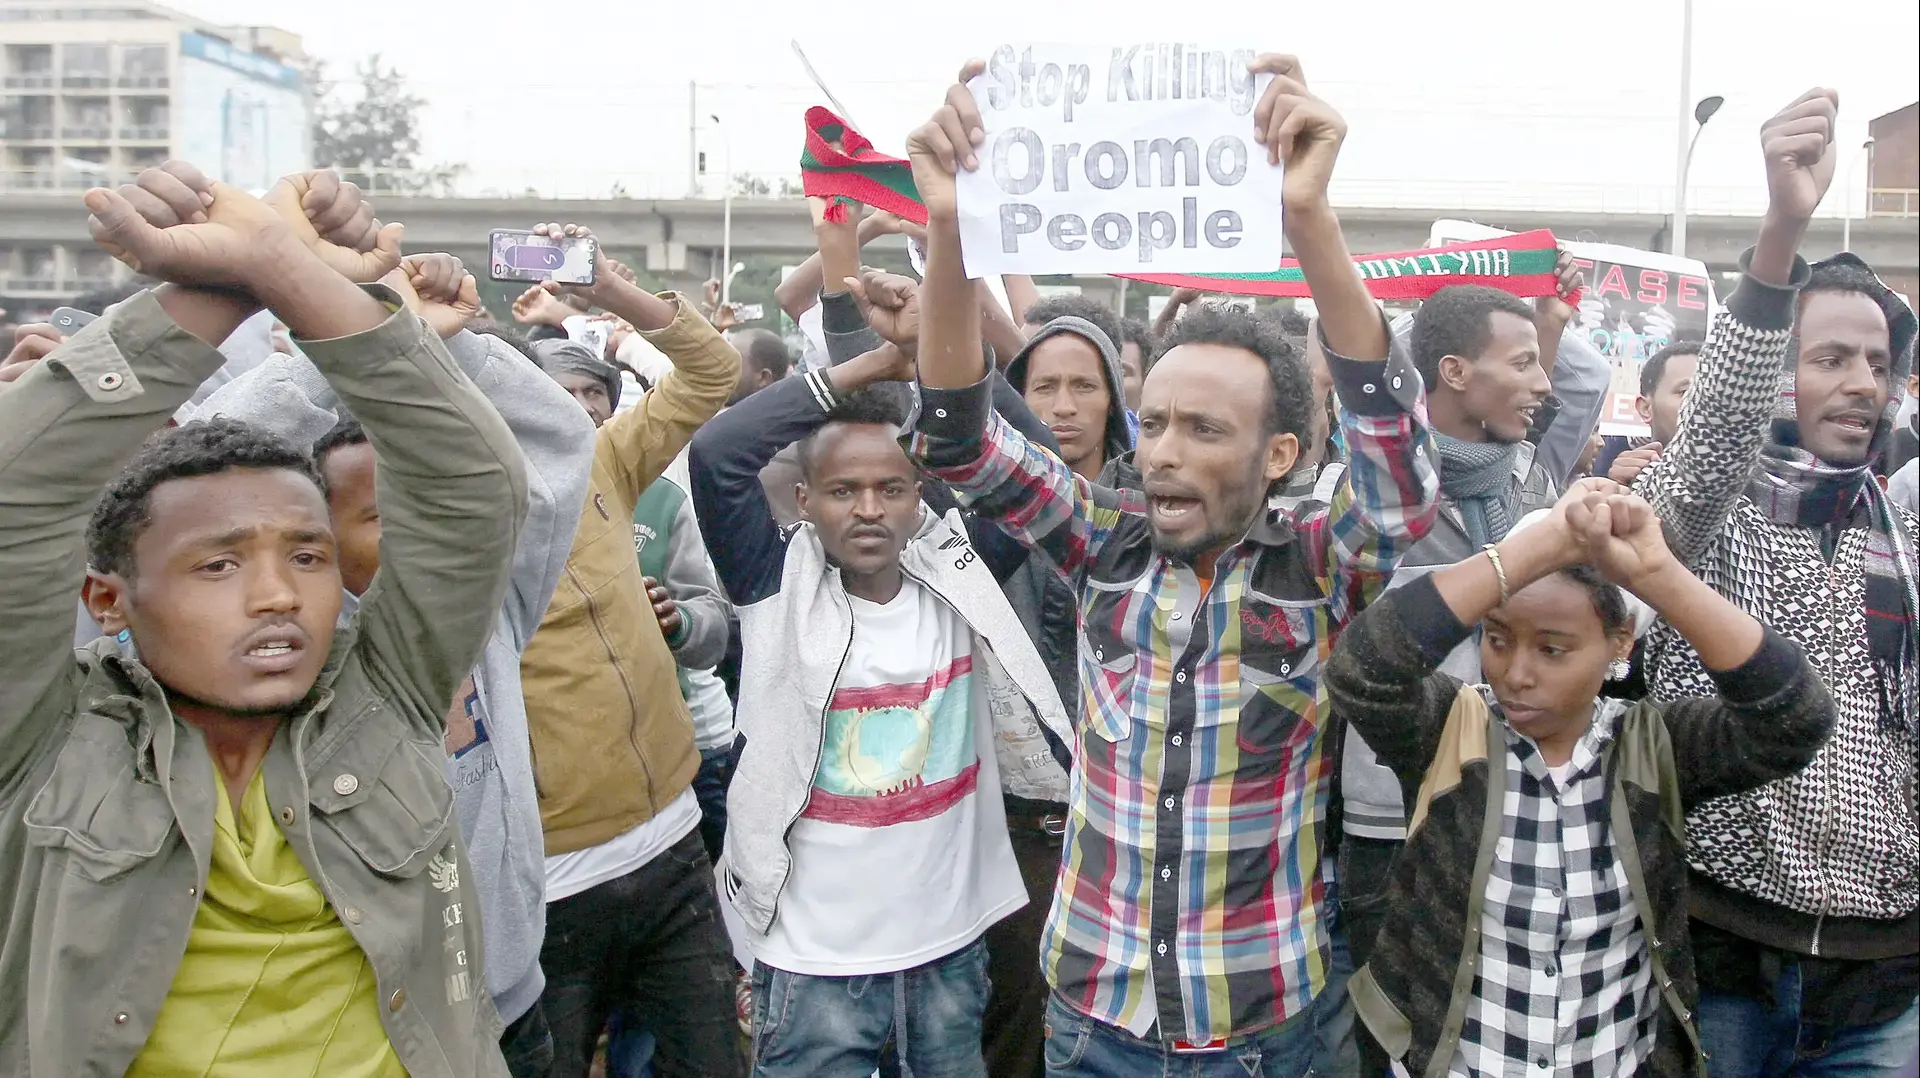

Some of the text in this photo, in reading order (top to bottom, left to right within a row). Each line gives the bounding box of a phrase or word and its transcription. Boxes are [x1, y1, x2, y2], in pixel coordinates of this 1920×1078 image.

[988, 43, 1255, 122] Stop Killing
[992, 126, 1248, 195] Oromo
[999, 197, 1243, 262] People
